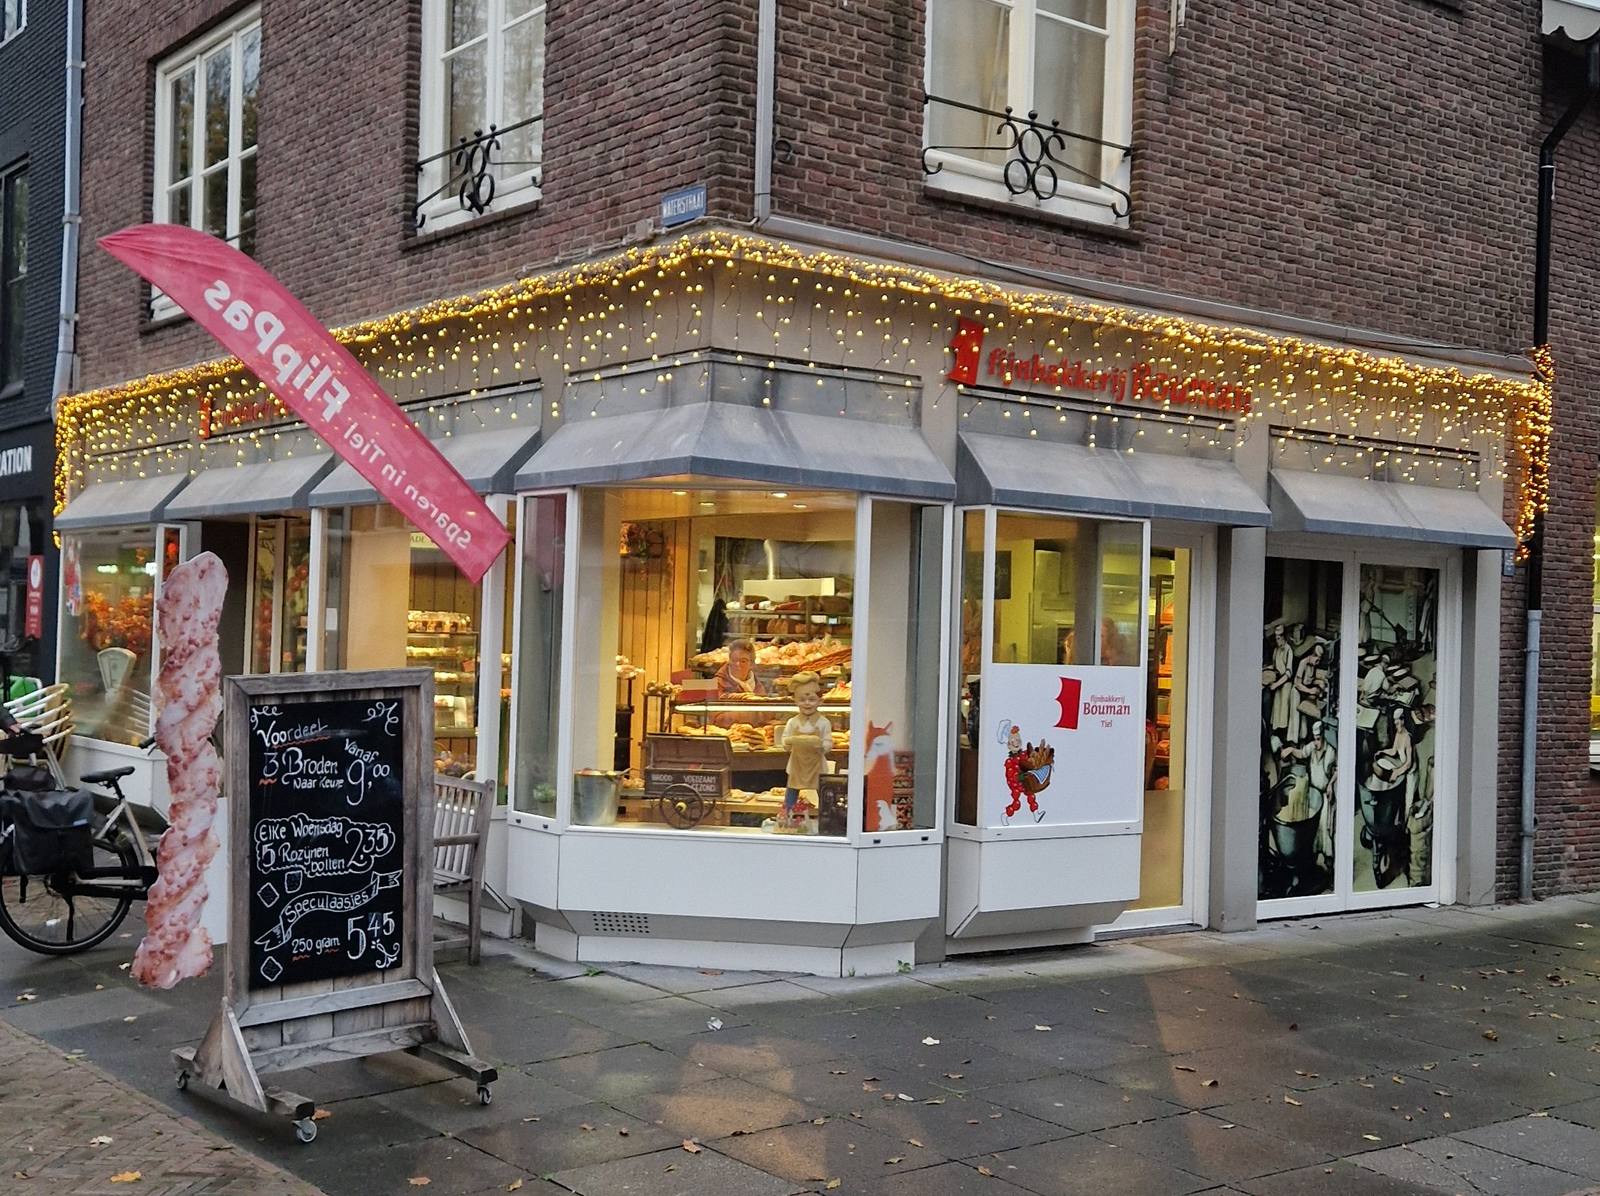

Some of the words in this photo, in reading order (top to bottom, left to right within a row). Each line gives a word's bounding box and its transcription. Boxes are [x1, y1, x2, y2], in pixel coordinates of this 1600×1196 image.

[0, 445, 32, 477] ATION
[1083, 702, 1131, 716] Bouman
[1100, 719, 1113, 728] Tiel
[263, 751, 280, 777] 3
[282, 747, 338, 785] Broden
[290, 818, 343, 838] Woensdag
[261, 842, 276, 867] 5
[284, 891, 369, 923] Speculaasjes
[291, 938, 314, 954] 250
[315, 936, 341, 955] gram
